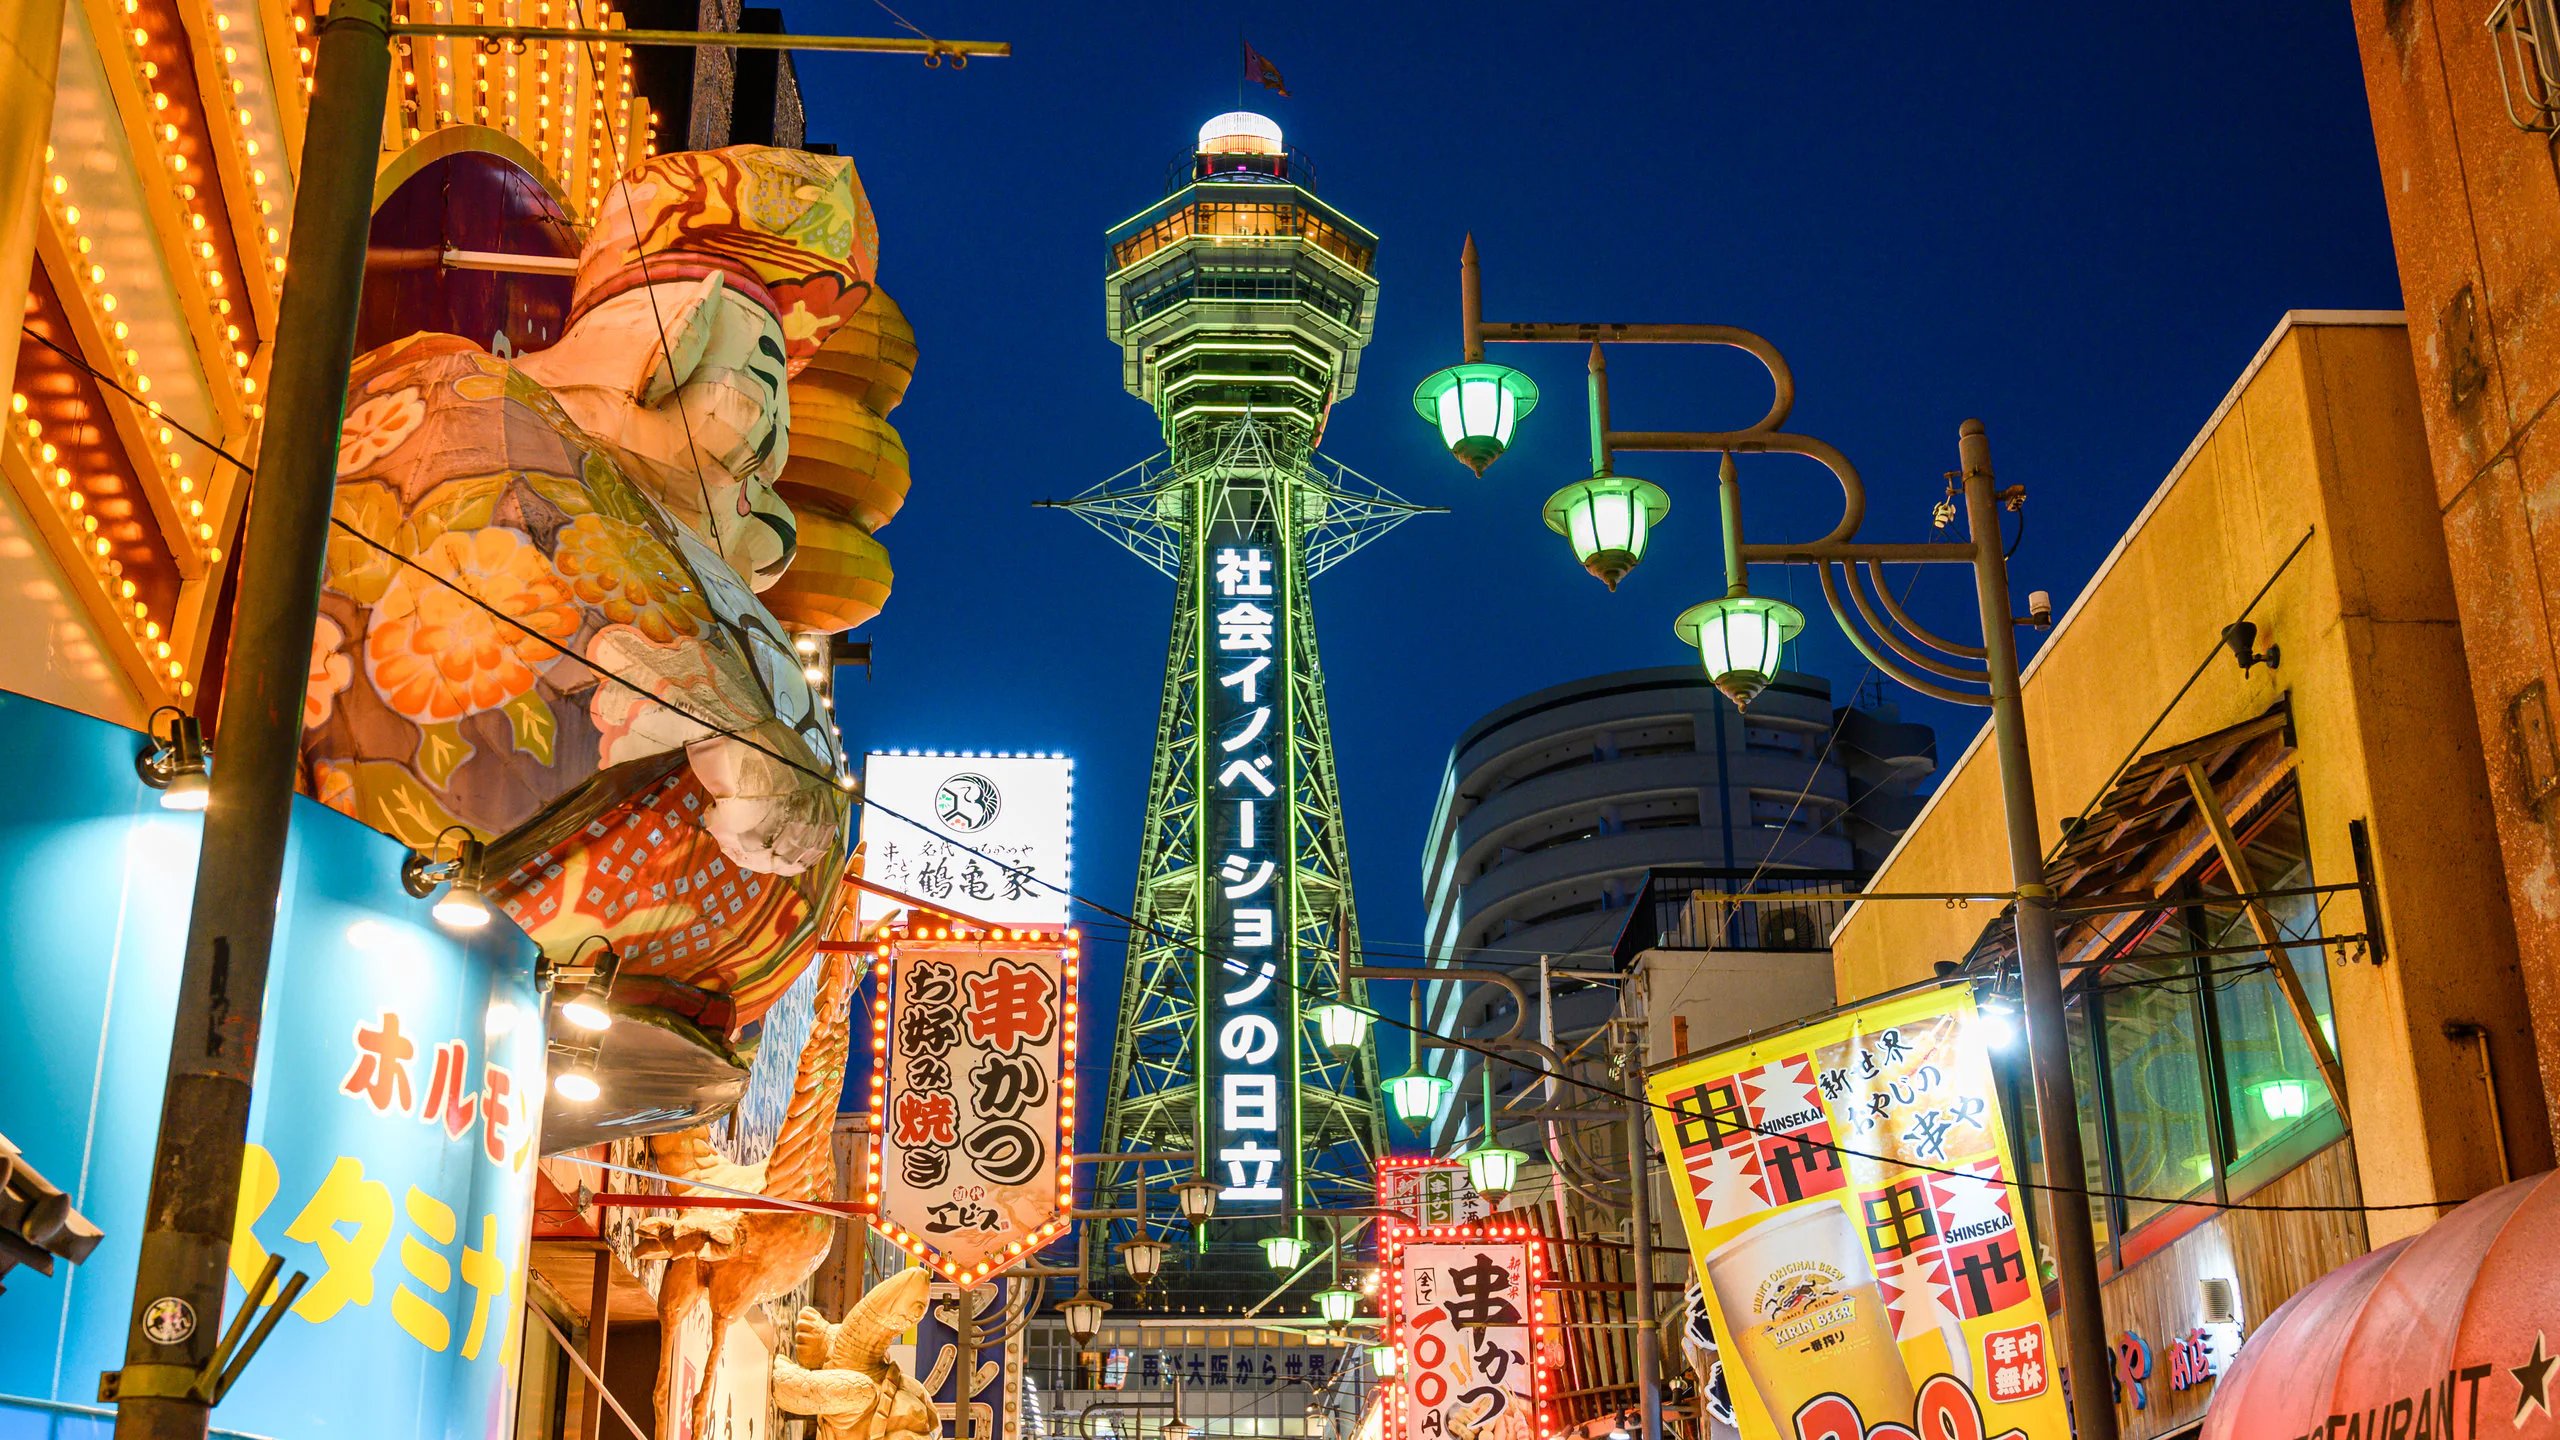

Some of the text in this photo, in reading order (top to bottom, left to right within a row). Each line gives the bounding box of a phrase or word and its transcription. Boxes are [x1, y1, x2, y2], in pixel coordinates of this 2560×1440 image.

[917, 856, 1041, 901] 鶴亀家
[1216, 547, 1283, 1202] 社会イノベーションの日立
[895, 961, 959, 1187] お好み焼き
[964, 960, 1053, 1184] 串かつ
[1819, 1030, 1914, 1100] 新世界
[1848, 1065, 1942, 1135] おやじの
[1430, 1178, 1449, 1221] 串かつ
[1416, 1270, 1434, 1303] 全て
[1769, 1260, 1817, 1282] ORIGINAL
[1818, 1261, 1846, 1282] BREW
[1443, 1253, 1526, 1428] 串かつ
[1774, 1305, 1854, 1345] KIRIN BEER
[1800, 1330, 1846, 1354] 一番搾り
[1992, 1329, 2040, 1364] 年中
[1994, 1358, 2043, 1396] 無休
